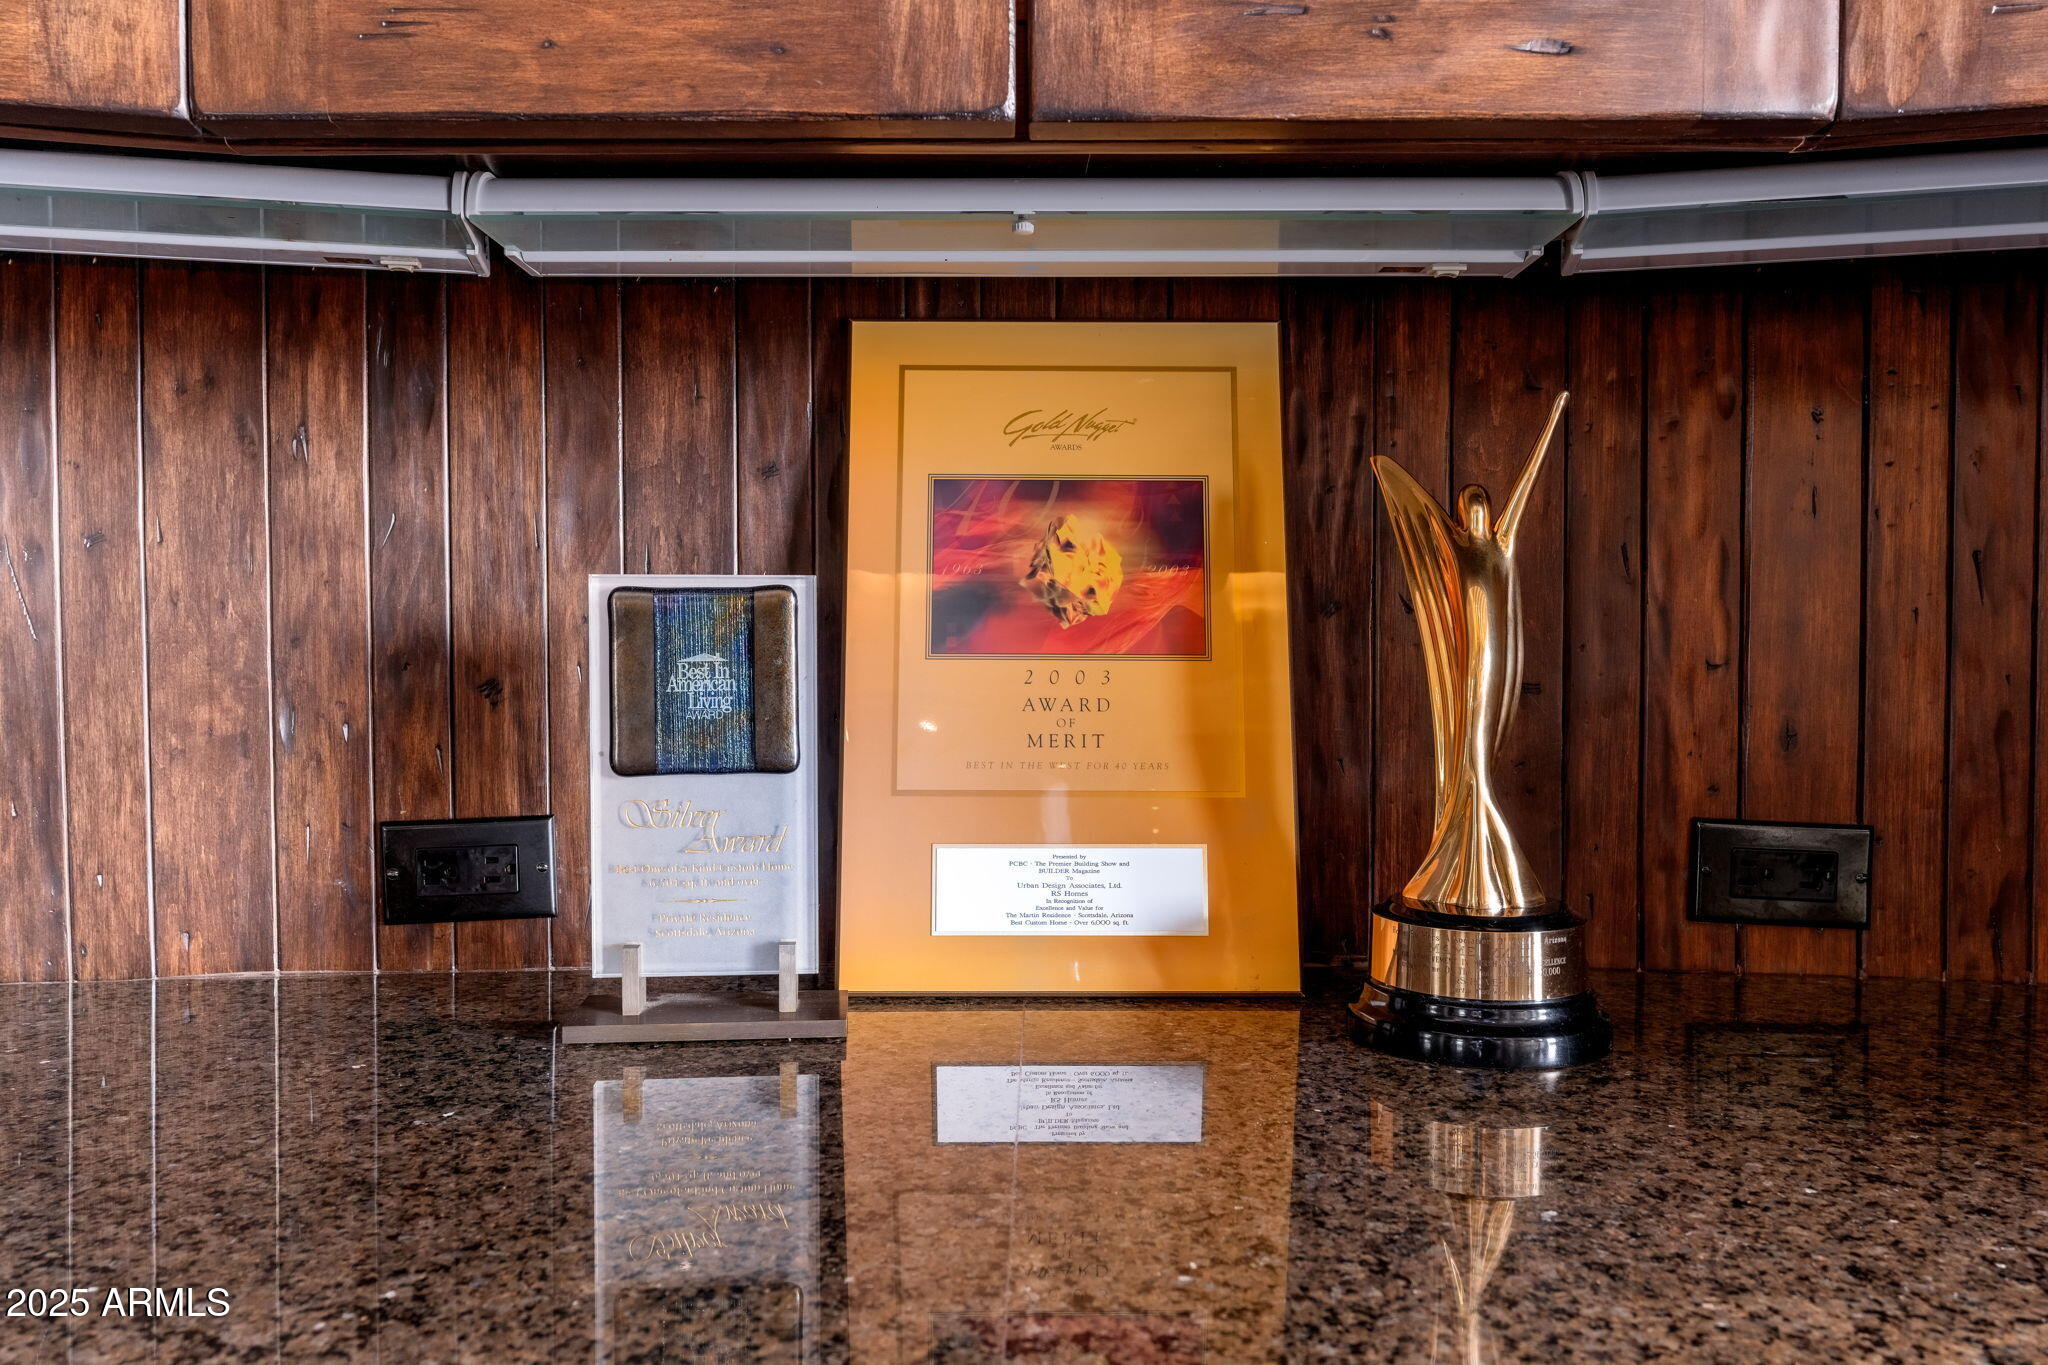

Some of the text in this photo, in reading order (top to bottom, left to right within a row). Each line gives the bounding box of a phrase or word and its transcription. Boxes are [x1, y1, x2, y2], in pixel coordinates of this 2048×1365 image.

[1003, 408, 1136, 447] Gold Nugget
[1050, 443, 1082, 451] AWARDS
[942, 562, 985, 576] 1963
[1146, 563, 1191, 577] 2003
[676, 661, 730, 680] Best In
[1023, 669, 1112, 686] 2003
[666, 673, 737, 693] American
[687, 691, 733, 714] Living
[1021, 696, 1112, 713] AWARD
[685, 710, 724, 720] AWARD
[1055, 718, 1078, 729] OF
[1026, 733, 1106, 749] MERIT
[965, 760, 995, 770] BEST
[1000, 760, 1015, 770] IN
[1019, 760, 1044, 770] THE
[1085, 760, 1110, 770] FOR
[1114, 760, 1128, 770] 40
[1132, 760, 1170, 770] YEARS
[624, 799, 727, 830] Silver
[684, 824, 789, 854] Award
[1074, 860, 1099, 868] Building
[1042, 882, 1066, 890] Design
[1069, 882, 1106, 890] Associates,
